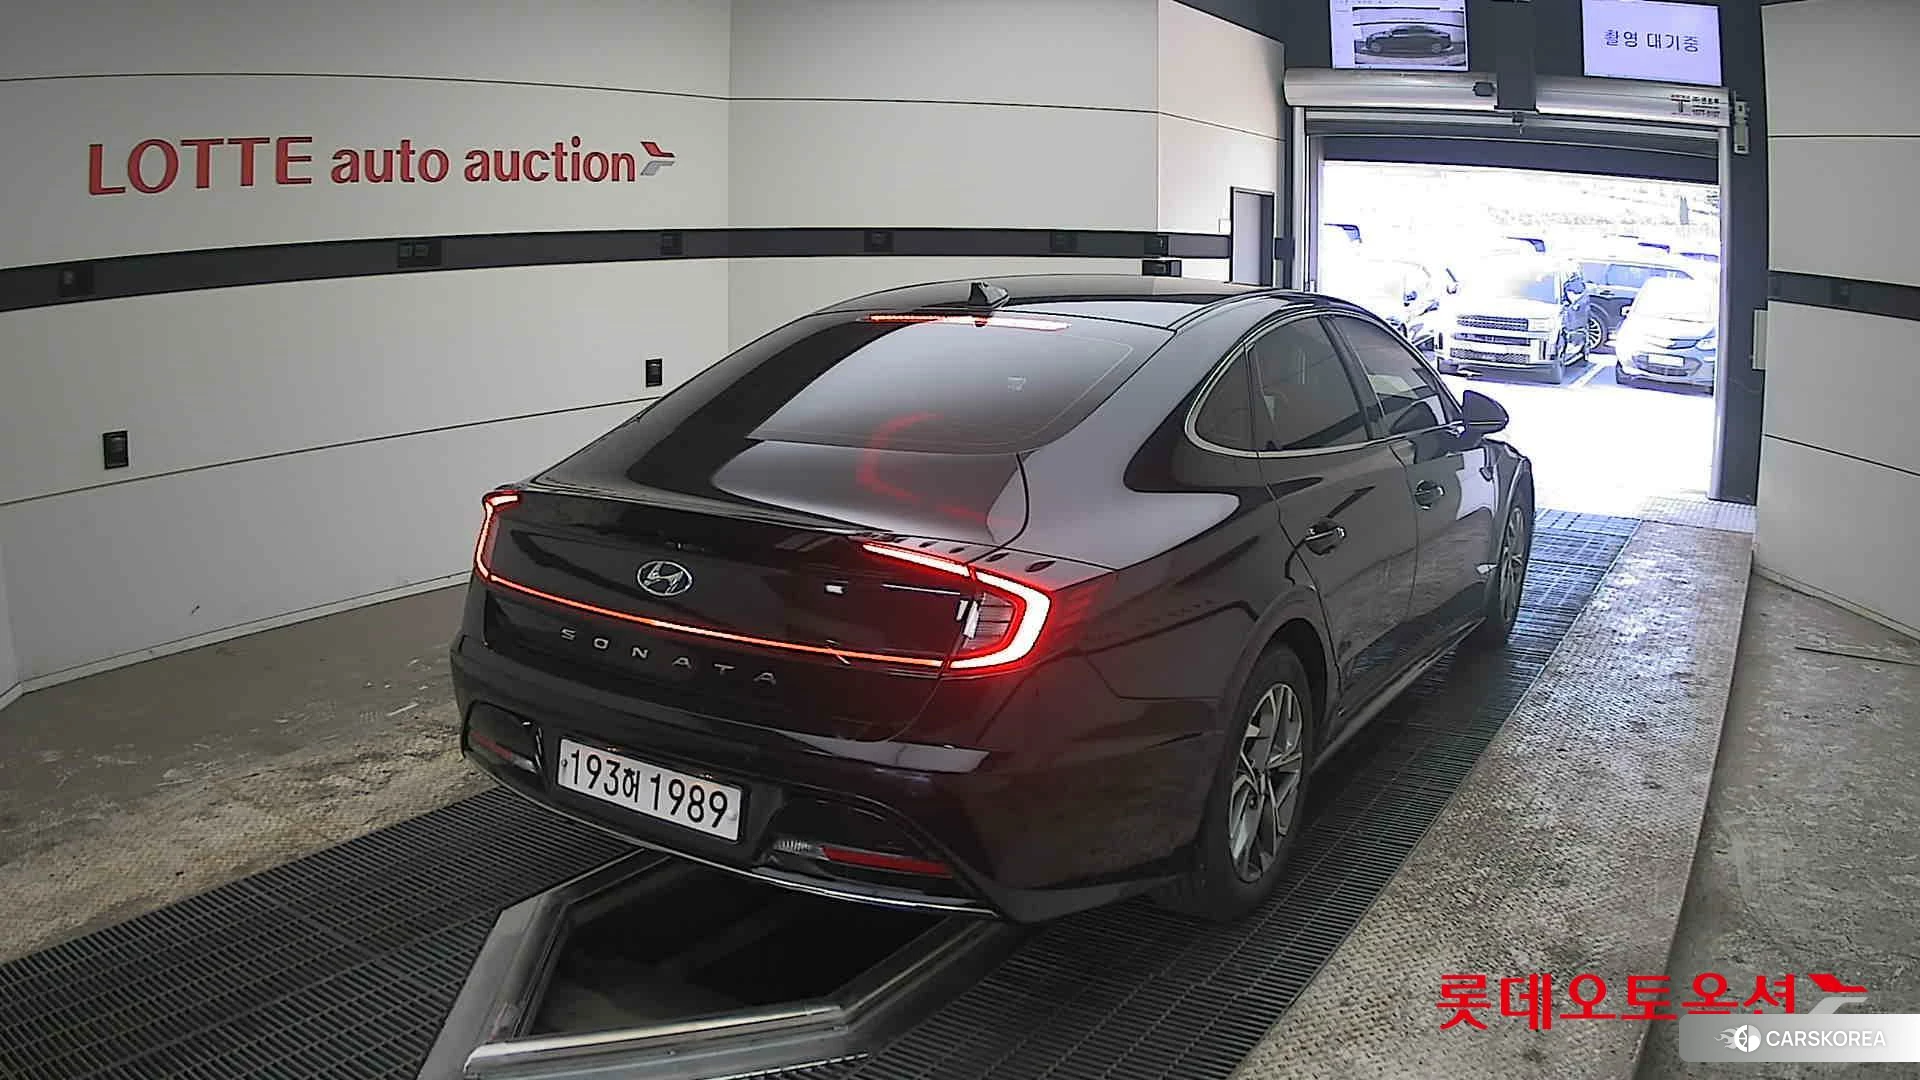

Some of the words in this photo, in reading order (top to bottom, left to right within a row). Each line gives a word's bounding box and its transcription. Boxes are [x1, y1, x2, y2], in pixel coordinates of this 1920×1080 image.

[1604, 29, 1638, 48] 촬영
[1646, 33, 1699, 53] 대기중
[89, 136, 313, 195] LOTTE
[330, 139, 450, 183] auto
[464, 136, 636, 182] auction
[560, 627, 777, 686] SONATA
